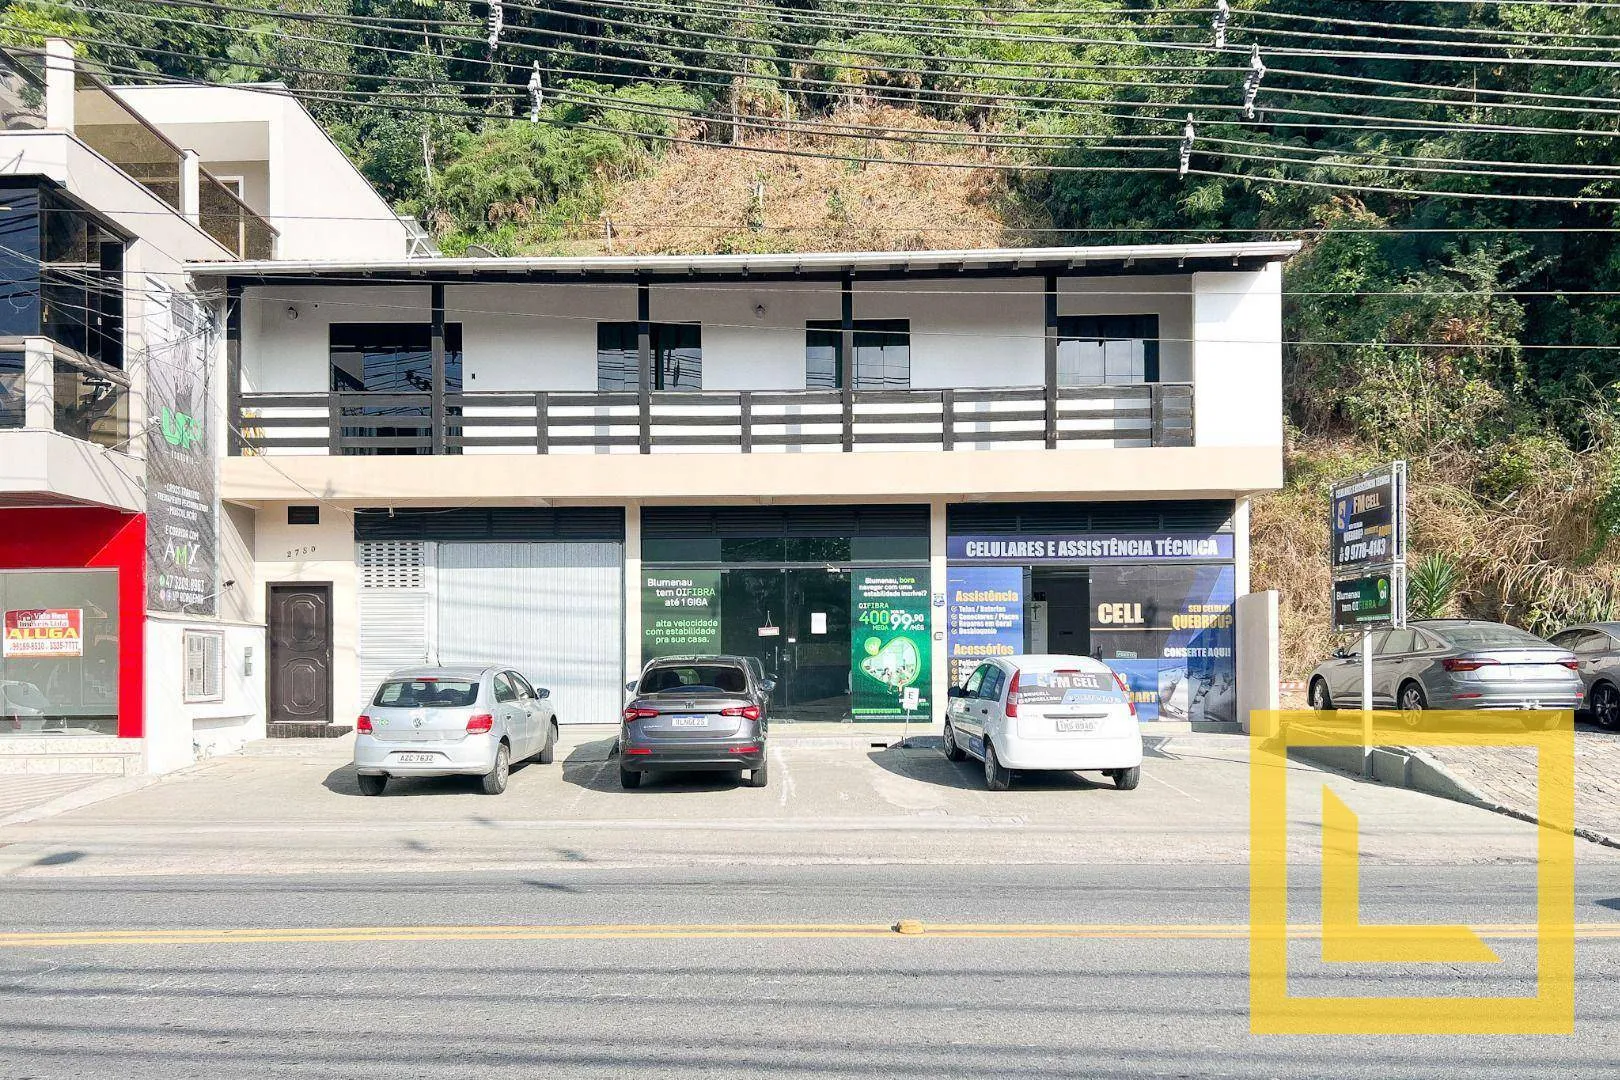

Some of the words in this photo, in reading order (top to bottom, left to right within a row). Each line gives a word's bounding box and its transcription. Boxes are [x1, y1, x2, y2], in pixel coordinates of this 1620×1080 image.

[1353, 493, 1366, 514] FM
[1366, 492, 1380, 510] CELL
[966, 540, 1045, 557] CELULARES
[1047, 540, 1057, 557] E
[1058, 538, 1153, 557] ASSISTÊNCIA
[1155, 538, 1219, 556] TÉCNICA
[647, 578, 693, 587] Blumenau
[899, 576, 916, 584] bora
[656, 589, 675, 597] tem
[675, 587, 716, 597] OIFIBRA
[955, 590, 1019, 602] Assistência
[664, 598, 680, 607] até
[681, 598, 686, 606] 1
[687, 597, 709, 607] GIGA
[1097, 602, 1145, 624] CELL
[1188, 604, 1202, 612] SEU
[673, 619, 718, 627] velocidade
[858, 610, 890, 625] 400
[1172, 614, 1233, 630] QUEBROU?
[8, 627, 79, 639] ALUGA
[665, 627, 716, 635] estabilidade
[655, 637, 670, 645] pra
[953, 643, 1014, 655] Acessórios
[1163, 647, 1207, 658] CONSERTE
[1050, 676, 1071, 688] FM
[1073, 677, 1100, 688] CELL
